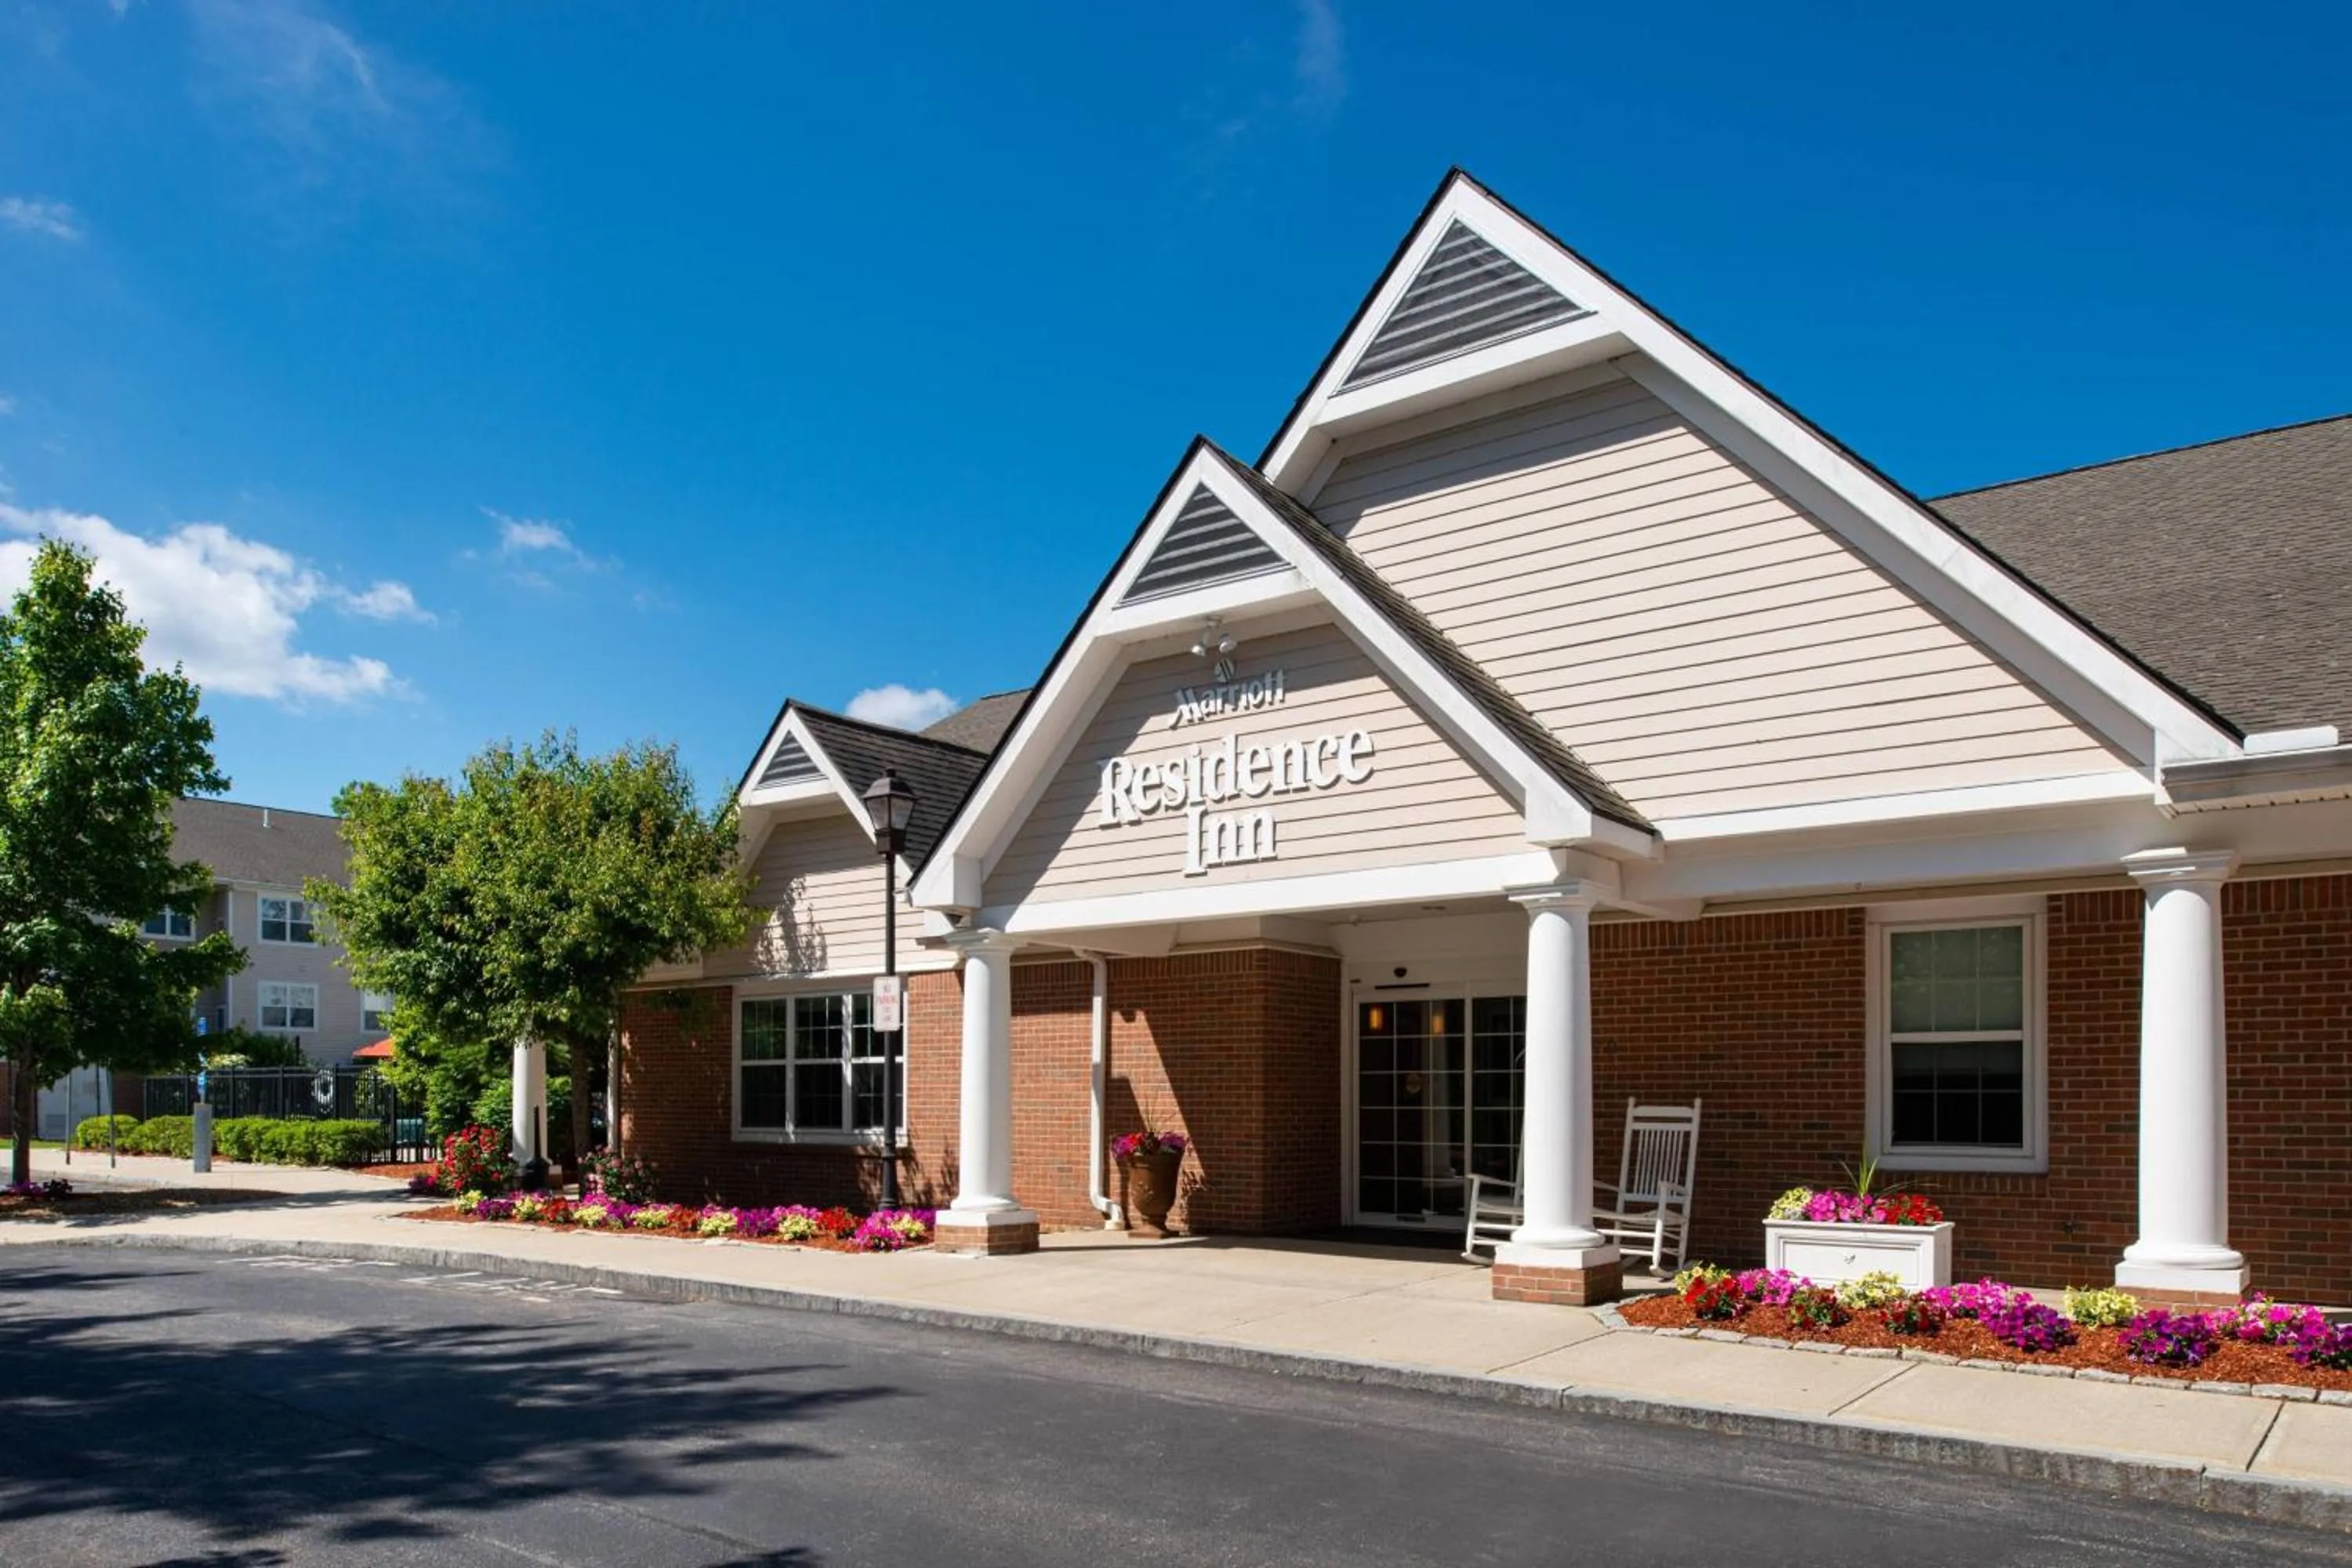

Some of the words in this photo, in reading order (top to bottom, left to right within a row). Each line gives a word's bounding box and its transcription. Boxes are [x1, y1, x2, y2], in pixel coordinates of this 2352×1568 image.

[1169, 668, 1286, 728] Marriott
[1098, 728, 1373, 826] Residence
[1185, 805, 1277, 874] Inn
